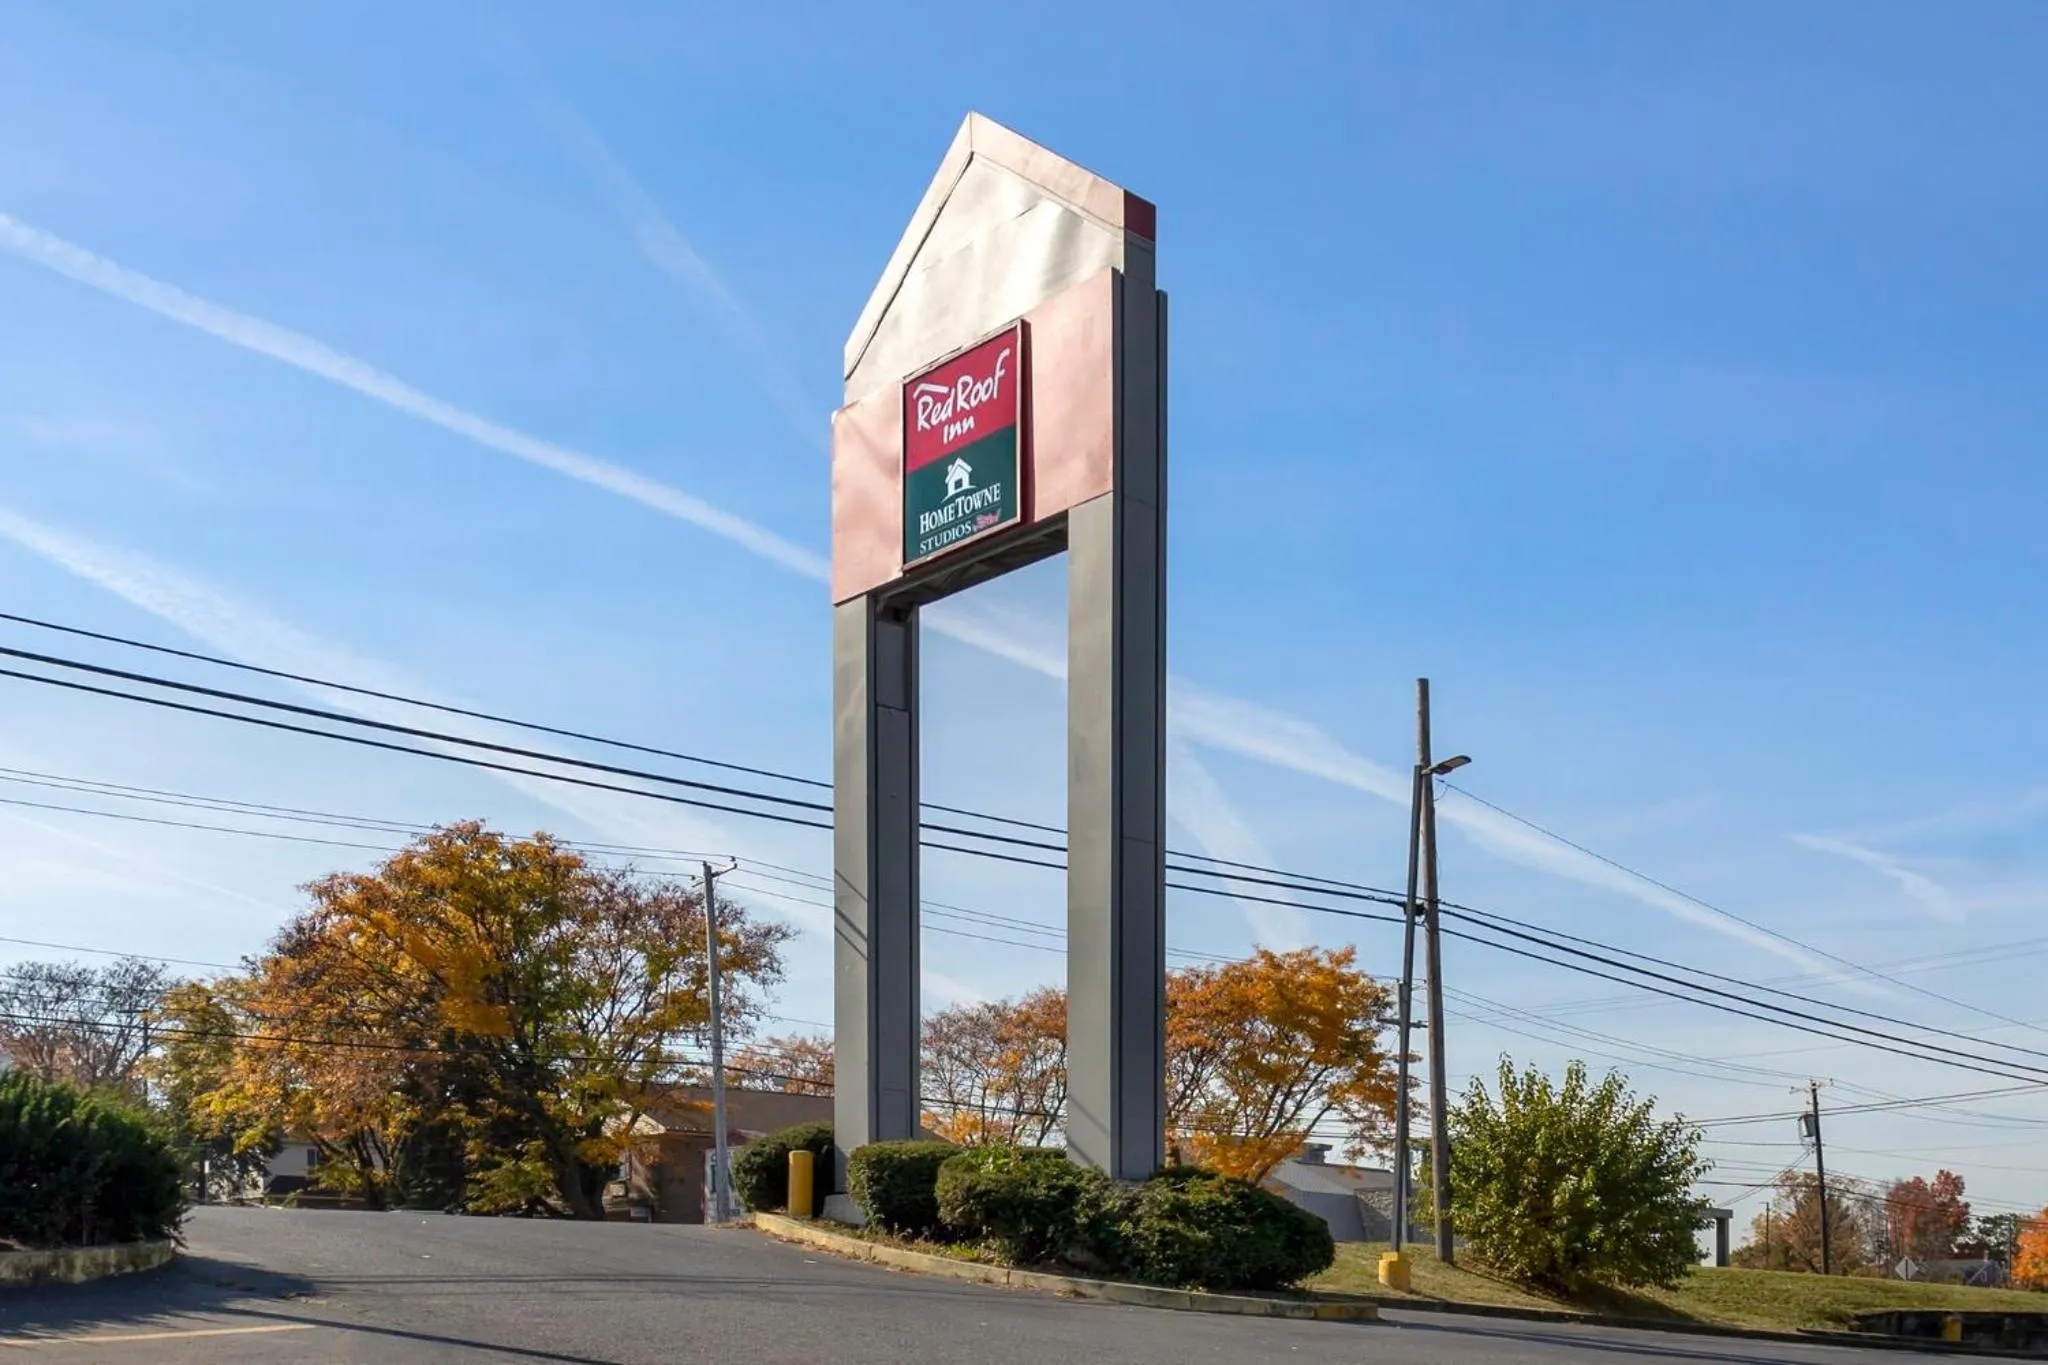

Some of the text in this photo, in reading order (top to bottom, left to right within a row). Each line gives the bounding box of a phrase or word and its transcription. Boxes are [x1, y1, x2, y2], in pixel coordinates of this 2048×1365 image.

[917, 347, 1010, 432] Red Roof
[919, 520, 972, 555] STUDIOS
